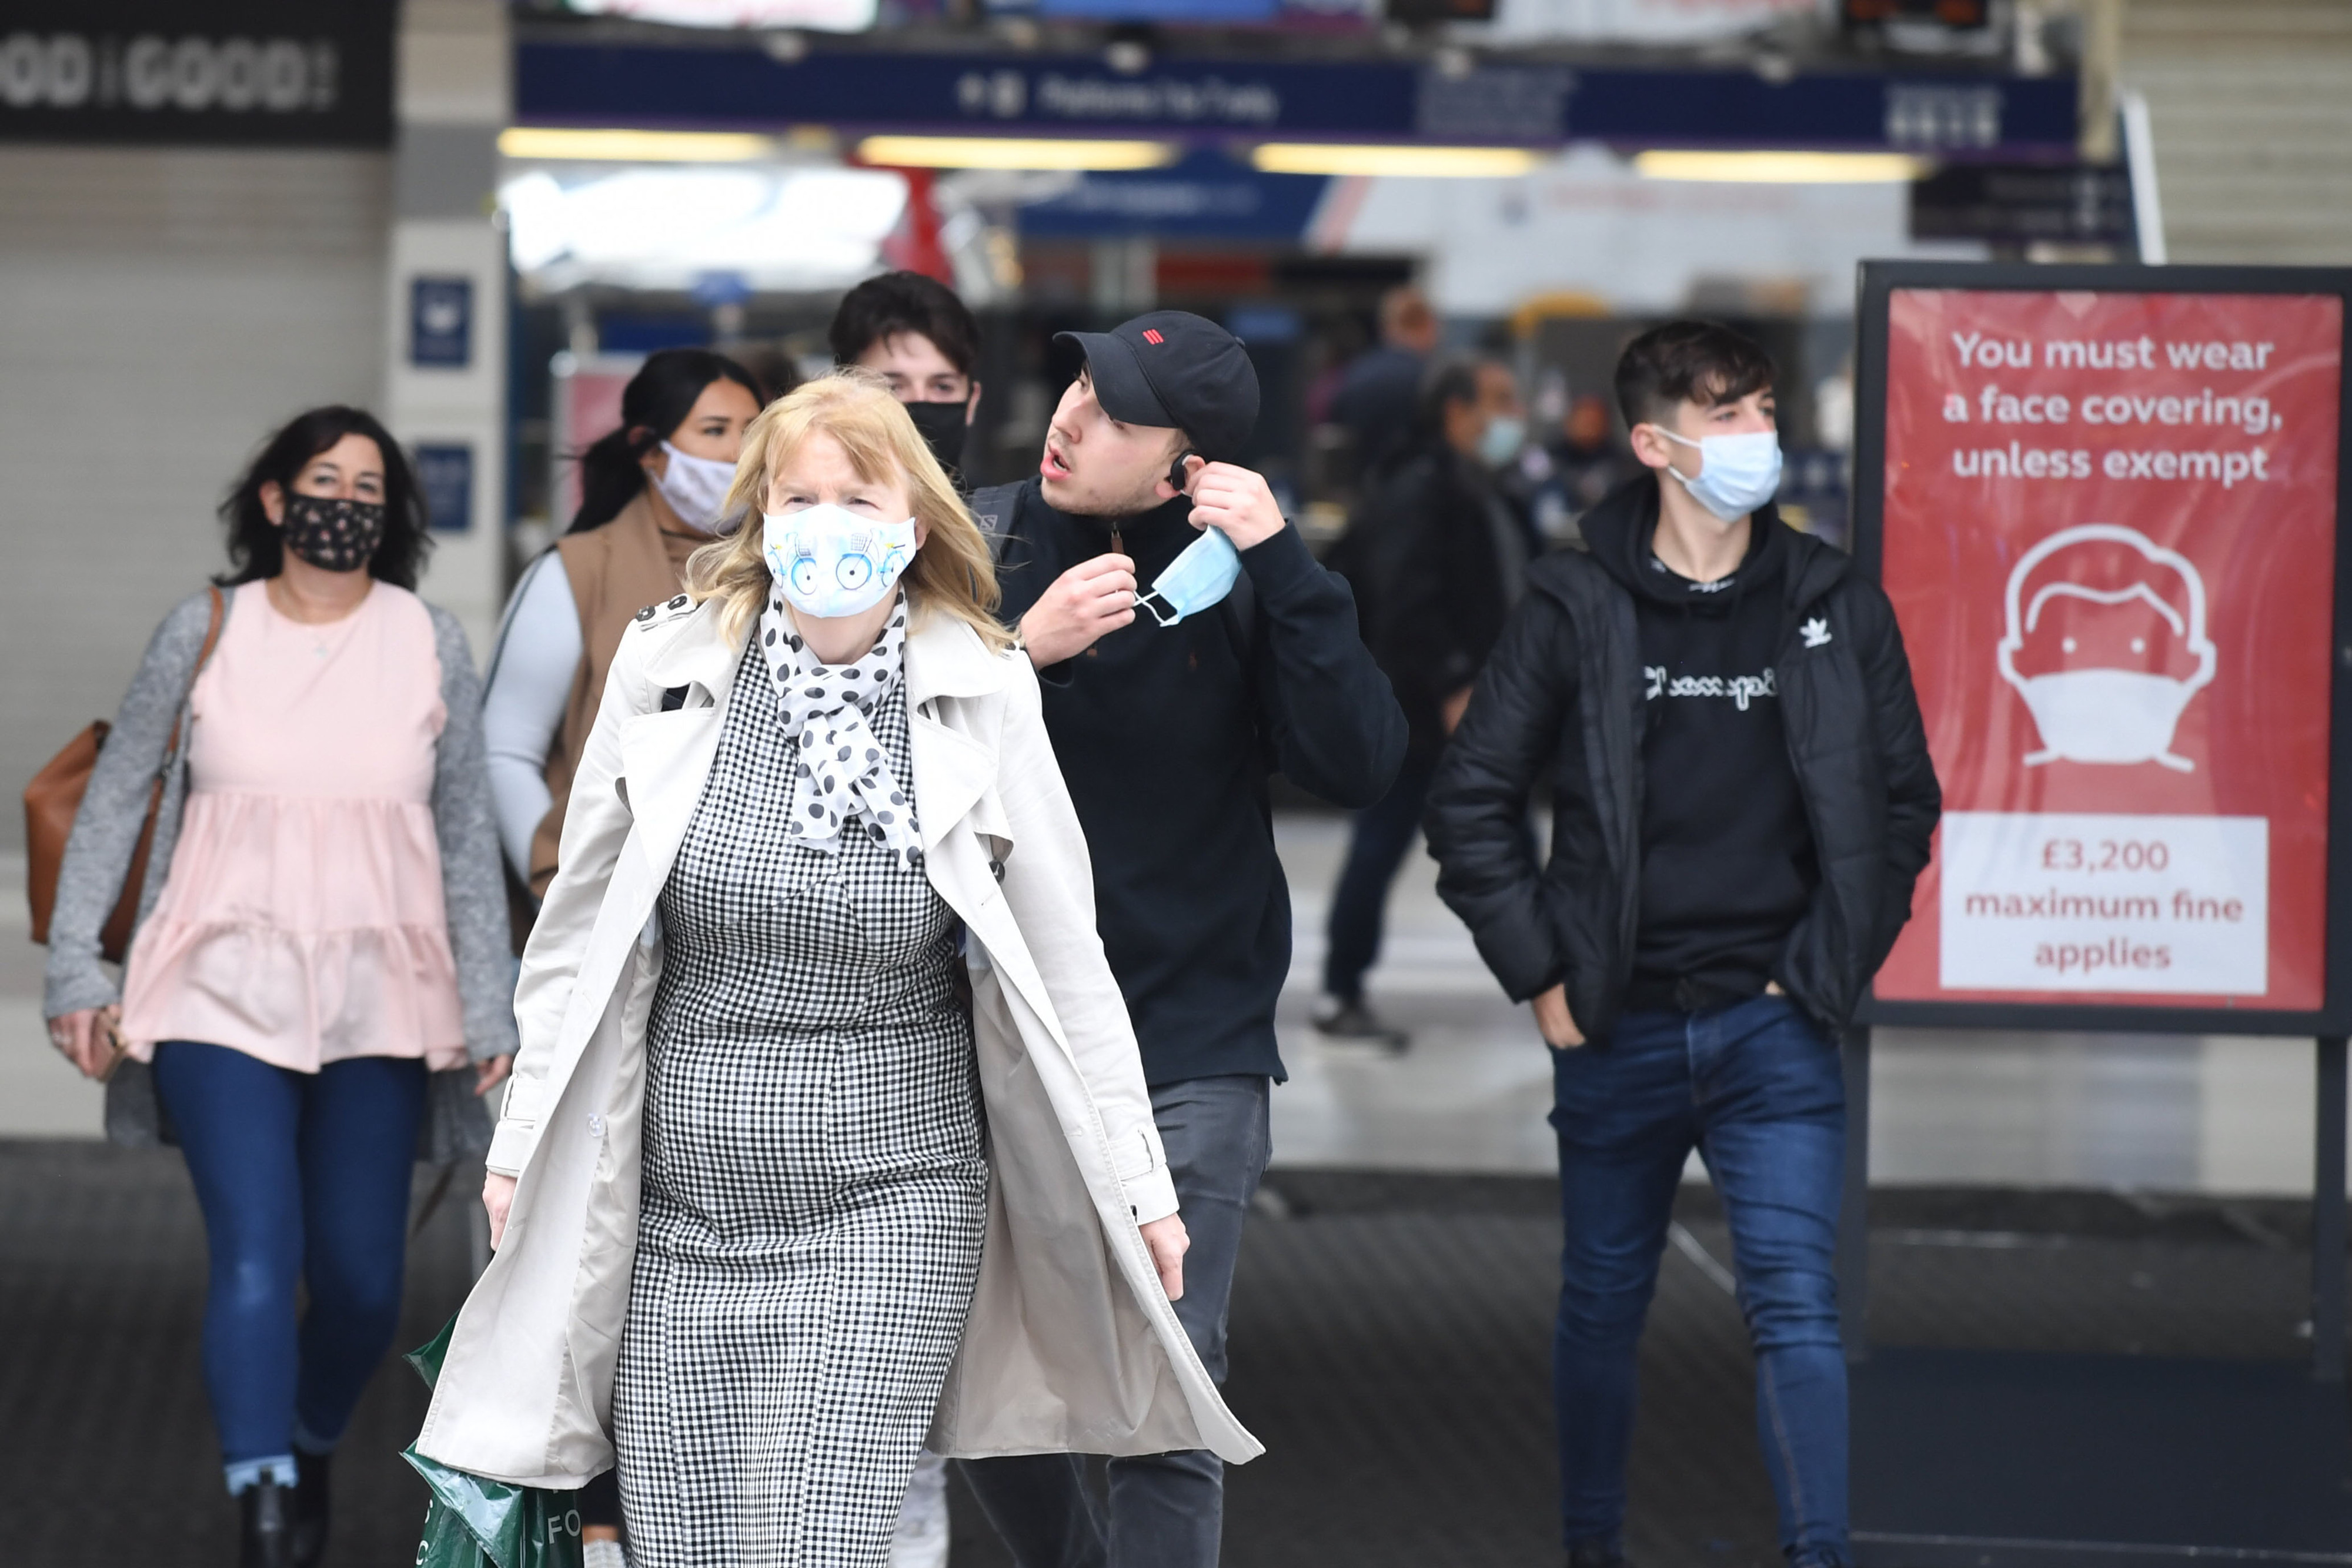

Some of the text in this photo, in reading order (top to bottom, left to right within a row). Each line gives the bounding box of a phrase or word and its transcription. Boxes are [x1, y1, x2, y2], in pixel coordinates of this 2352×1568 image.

[1952, 331, 2274, 370] You must wear
[1943, 386, 2282, 434] a face covering,
[1953, 442, 2269, 487] unless exempt
[2042, 839, 2169, 873] £3,200
[1966, 887, 2244, 922] maximum fine
[2034, 938, 2171, 974] applies
